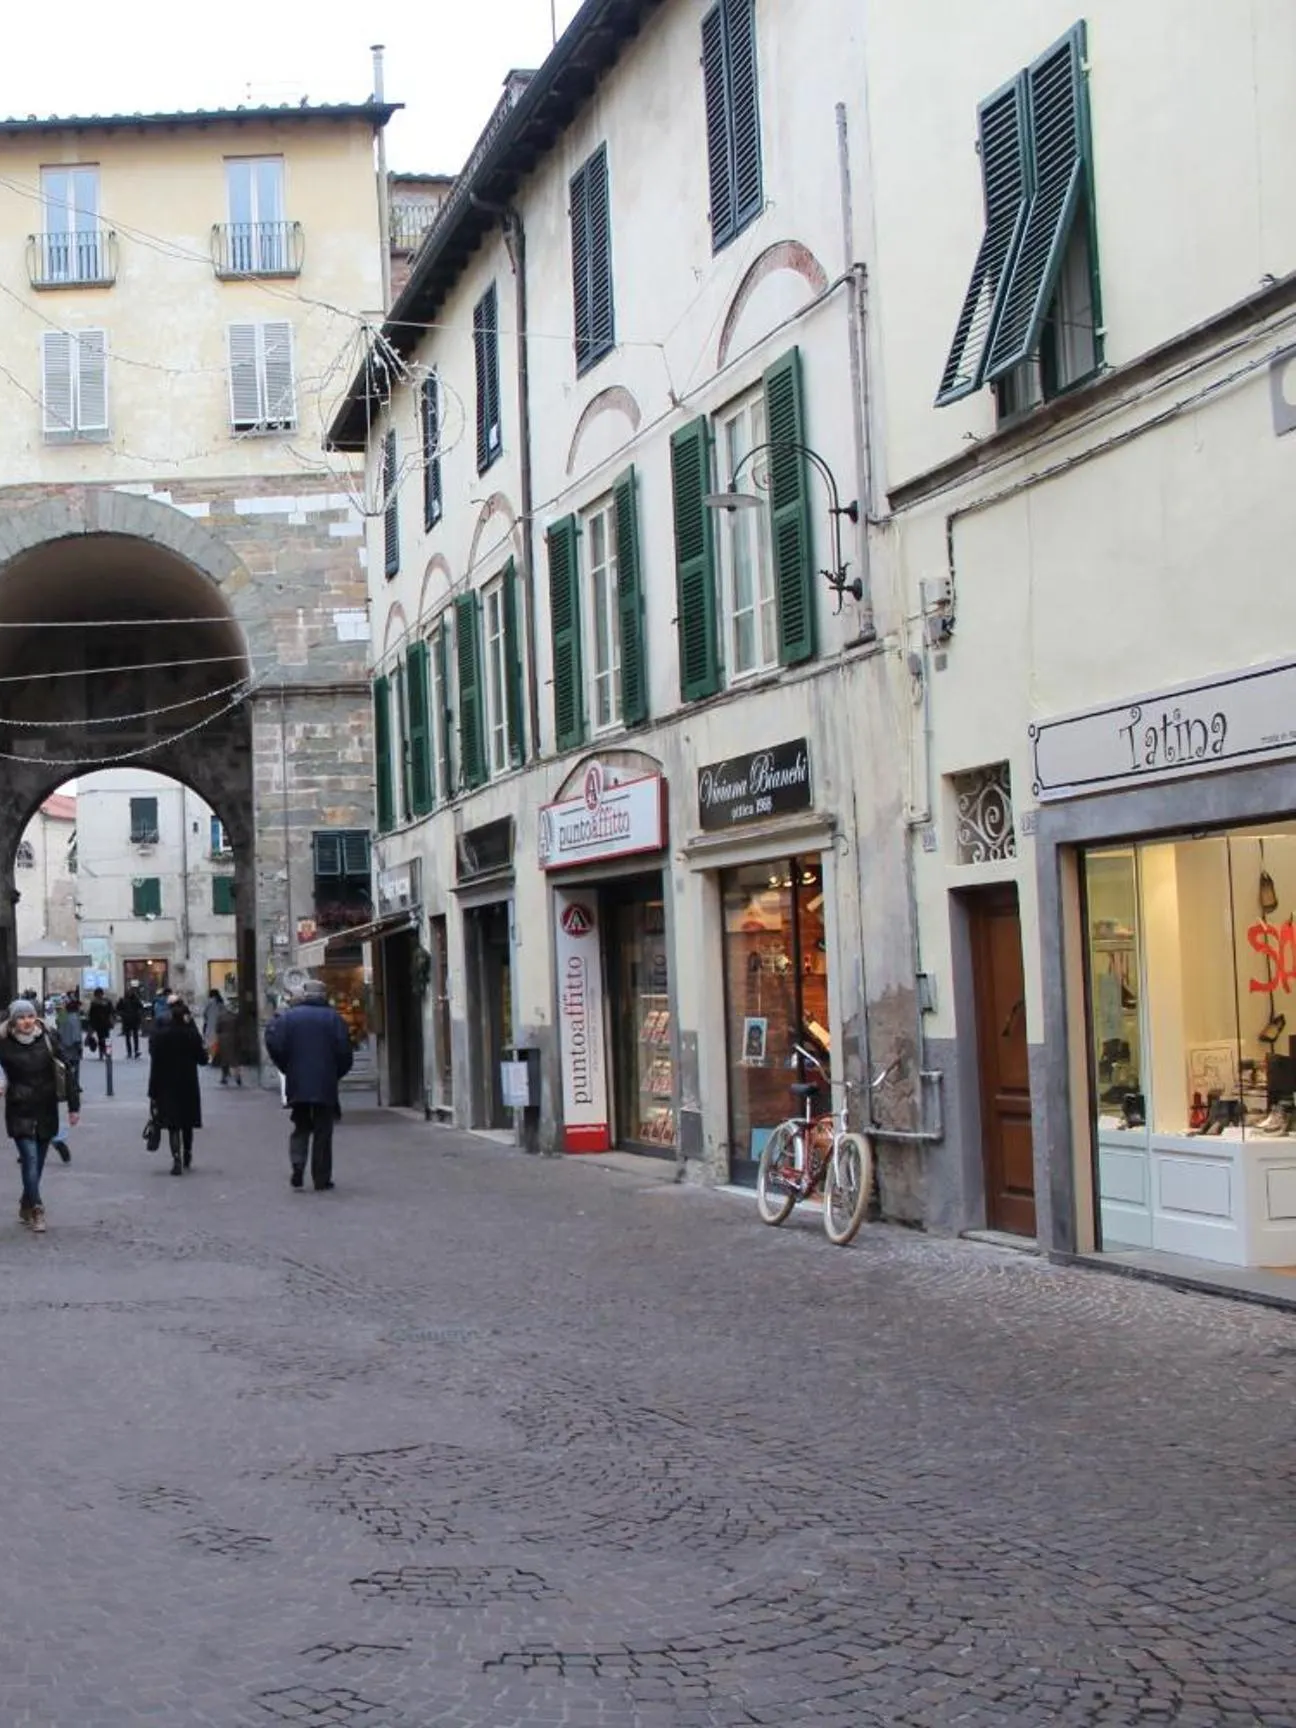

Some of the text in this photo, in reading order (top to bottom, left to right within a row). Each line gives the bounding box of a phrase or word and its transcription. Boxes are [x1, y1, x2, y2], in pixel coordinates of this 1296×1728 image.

[1119, 705, 1227, 770] Tatina
[699, 752, 807, 808] Viviana Bianchi
[559, 806, 630, 846] puntoaffitto
[563, 955, 592, 1106] puntoaffitto
